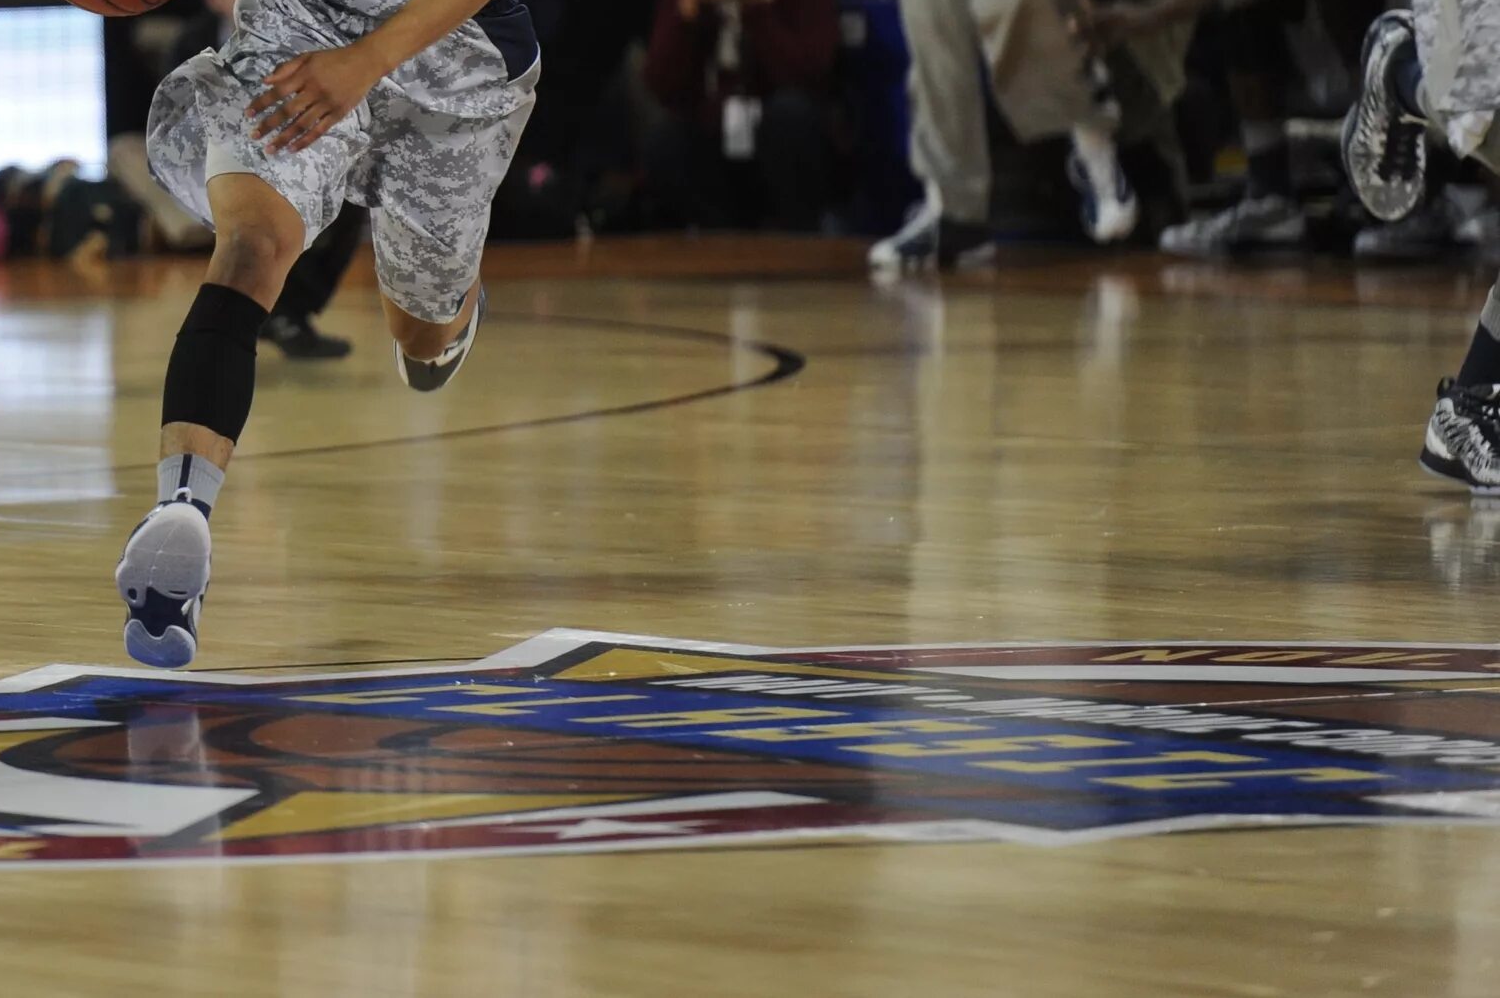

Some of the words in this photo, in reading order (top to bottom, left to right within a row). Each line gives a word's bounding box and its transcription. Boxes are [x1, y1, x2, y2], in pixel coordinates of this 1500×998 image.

[283, 683, 1398, 792] CLASSIC
[649, 674, 959, 699] NAVY
[923, 697, 1325, 734] MARINE
